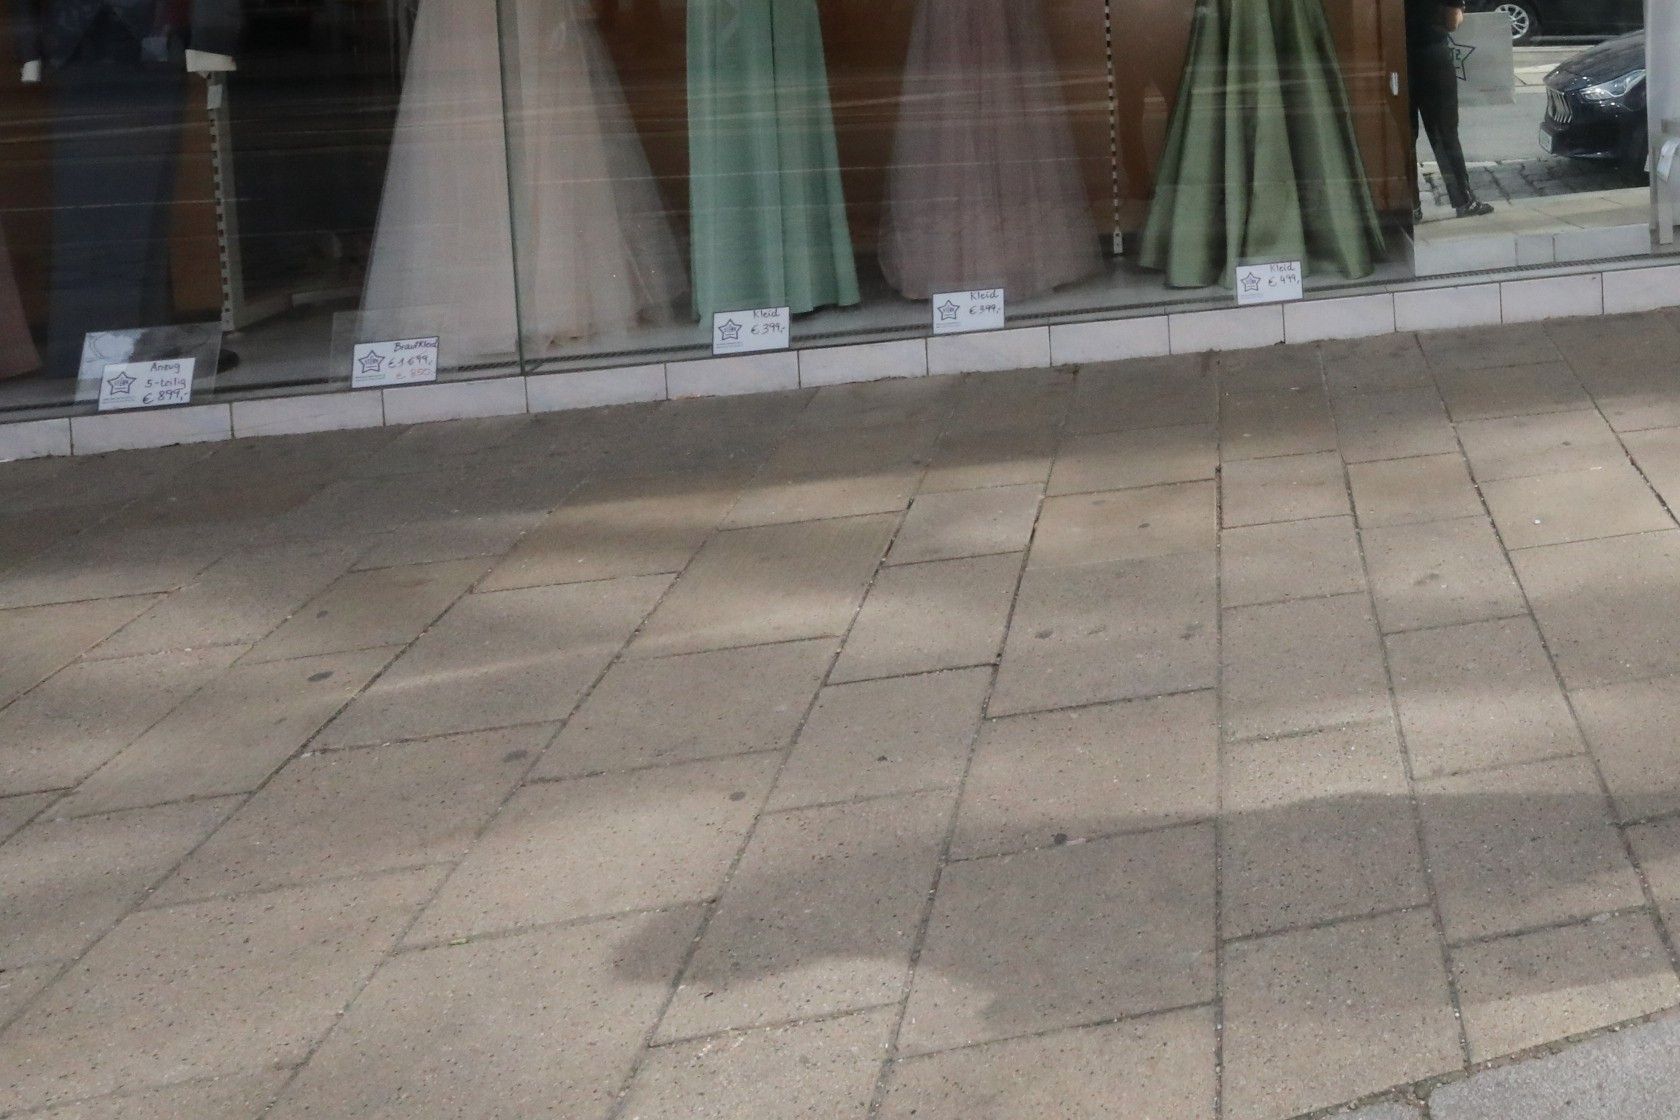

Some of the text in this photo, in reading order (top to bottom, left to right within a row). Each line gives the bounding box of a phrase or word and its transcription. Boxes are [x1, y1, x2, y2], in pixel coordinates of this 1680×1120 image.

[1270, 261, 1295, 272] Kleid
[970, 290, 999, 301] Kleid
[752, 308, 780, 319] Kleid
[150, 362, 181, 374] Anzug
